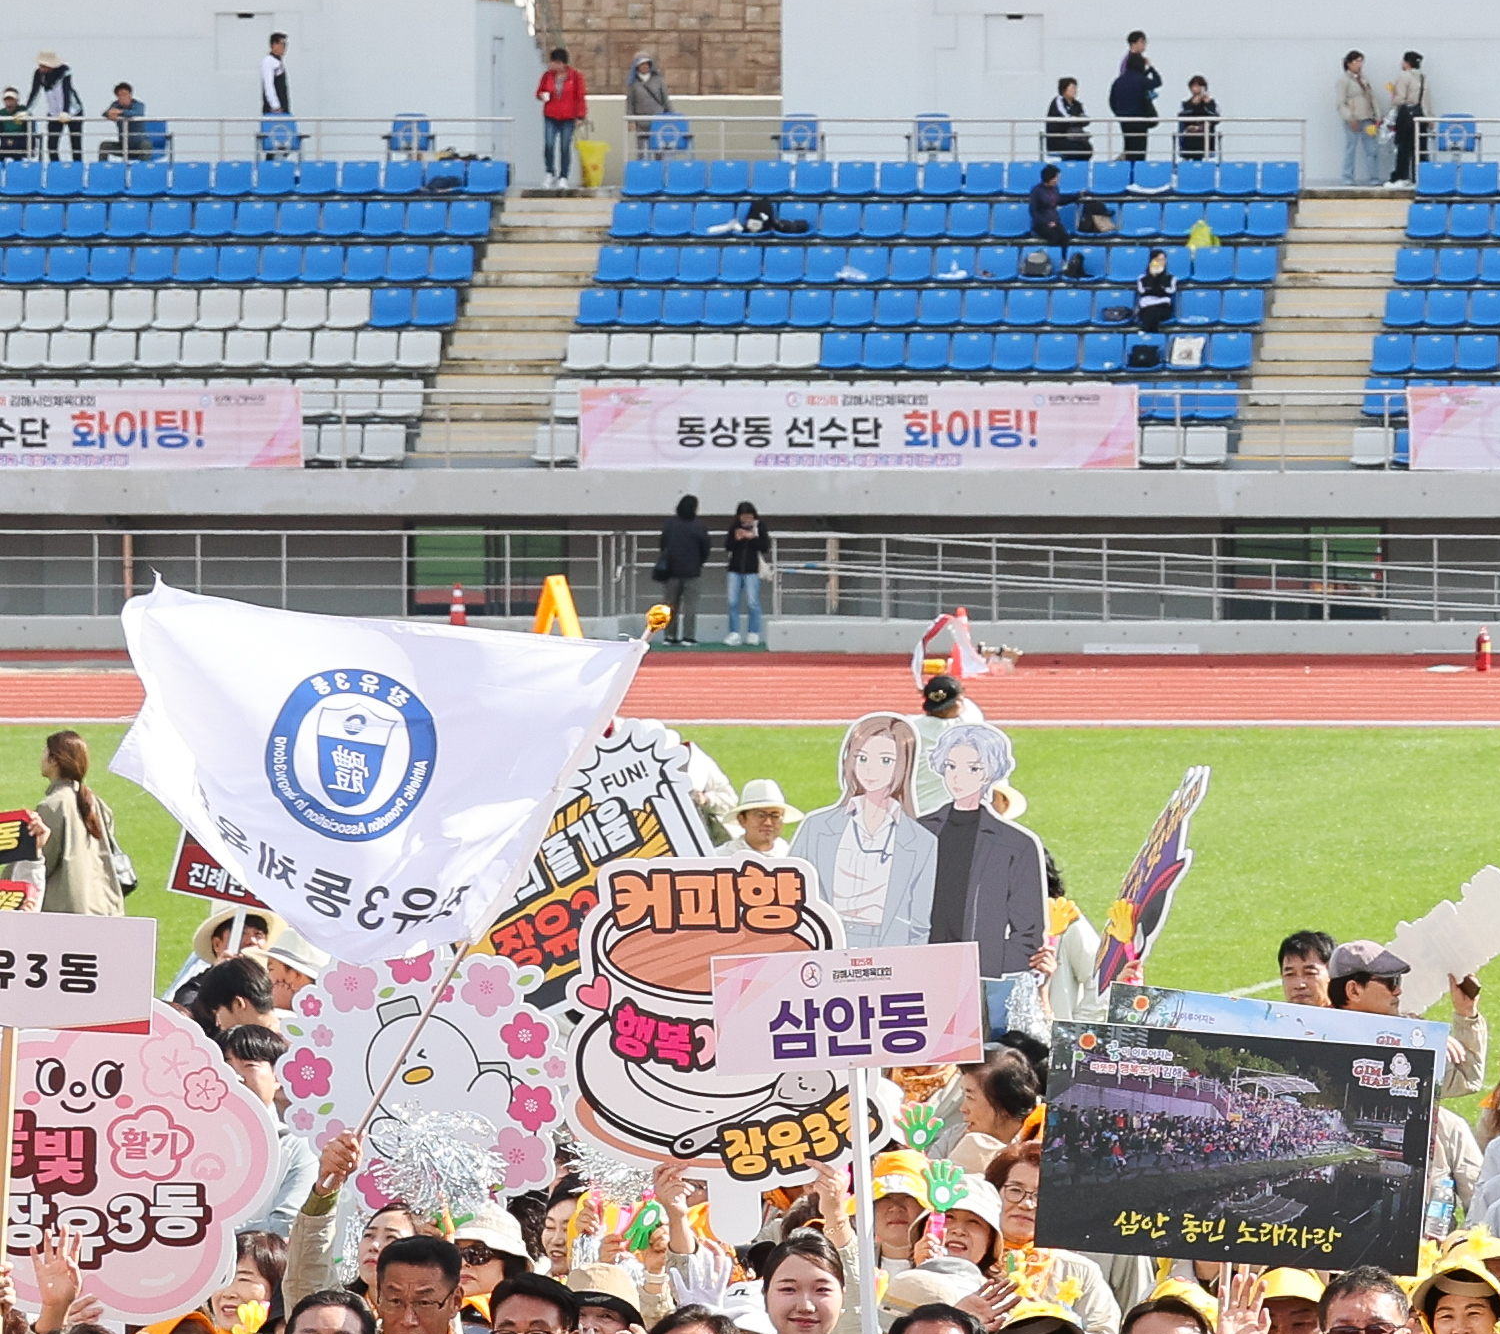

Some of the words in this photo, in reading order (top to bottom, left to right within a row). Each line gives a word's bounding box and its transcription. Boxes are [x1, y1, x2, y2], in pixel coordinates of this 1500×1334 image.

[71, 409, 205, 449] 화이팅!
[676, 414, 773, 449] 동상동
[785, 414, 883, 449] 선수단
[903, 408, 1039, 449] 화이팅!
[600, 760, 650, 794] FUN!
[541, 799, 637, 883] 즐거움
[613, 864, 807, 930] 커피향
[768, 992, 928, 1061] 삼안동
[121, 1127, 180, 1161] 활기
[8, 1184, 204, 1262] 장유3동
[1113, 1210, 1170, 1239] 삼안
[1181, 1213, 1225, 1244] 동민
[1236, 1221, 1342, 1254] 노래자랑
